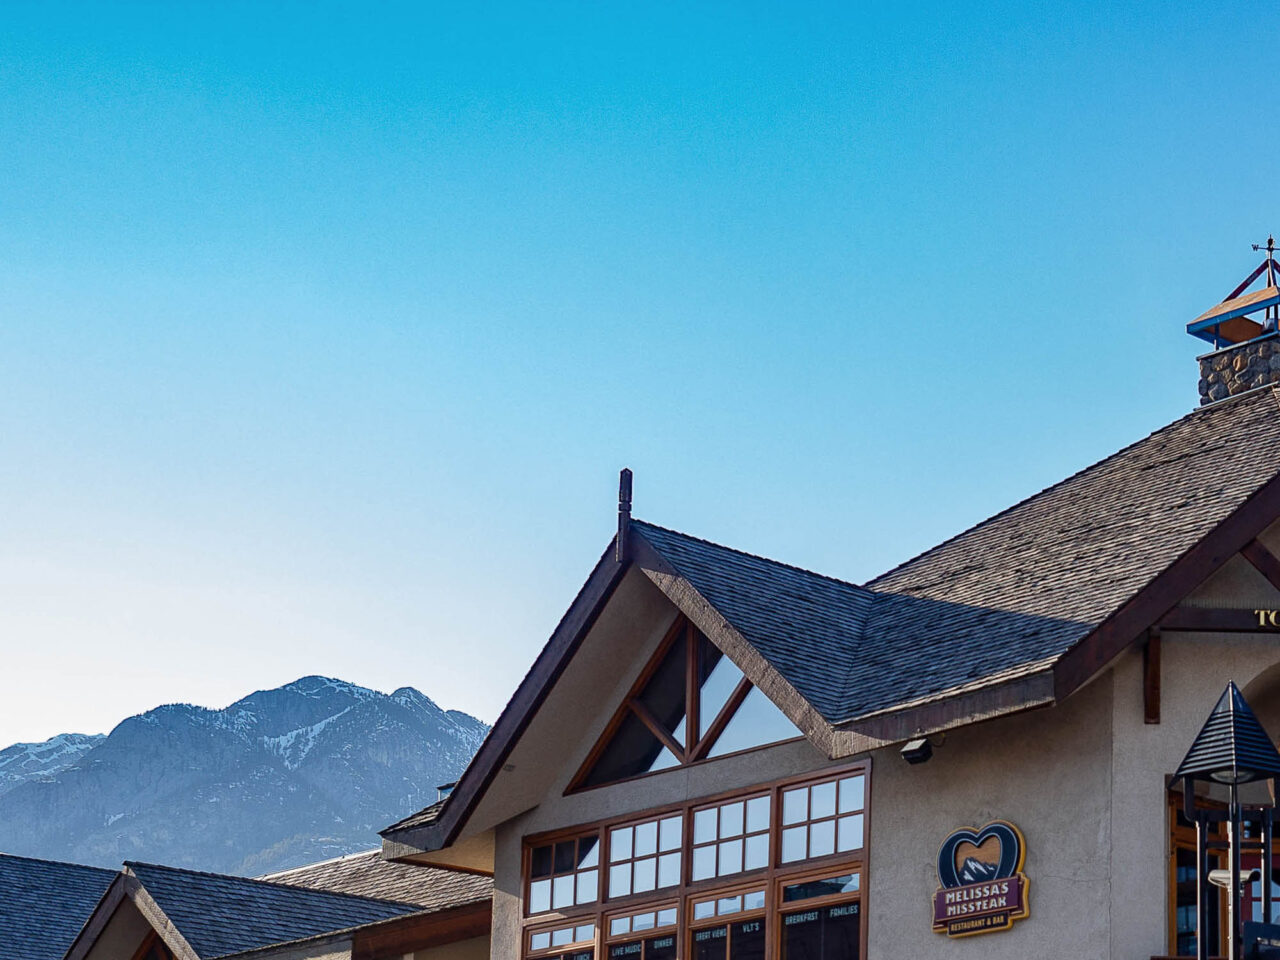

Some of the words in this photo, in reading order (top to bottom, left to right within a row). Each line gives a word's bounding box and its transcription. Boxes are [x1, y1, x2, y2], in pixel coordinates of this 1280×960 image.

[945, 882, 1009, 904] MELISSA'S
[785, 911, 819, 925] BREAKFAST
[829, 904, 858, 918] FAMILIES
[946, 897, 1007, 916] MISSTEAK
[695, 930, 711, 942] GREAT
[712, 928, 727, 939] VIEWS
[742, 922, 760, 934] VLT'S
[951, 919, 985, 932] RESTAURANT
[992, 915, 1005, 924] BAR
[611, 946, 624, 957] LIVE
[625, 943, 642, 955] MUSIC
[653, 937, 673, 949] DINNER
